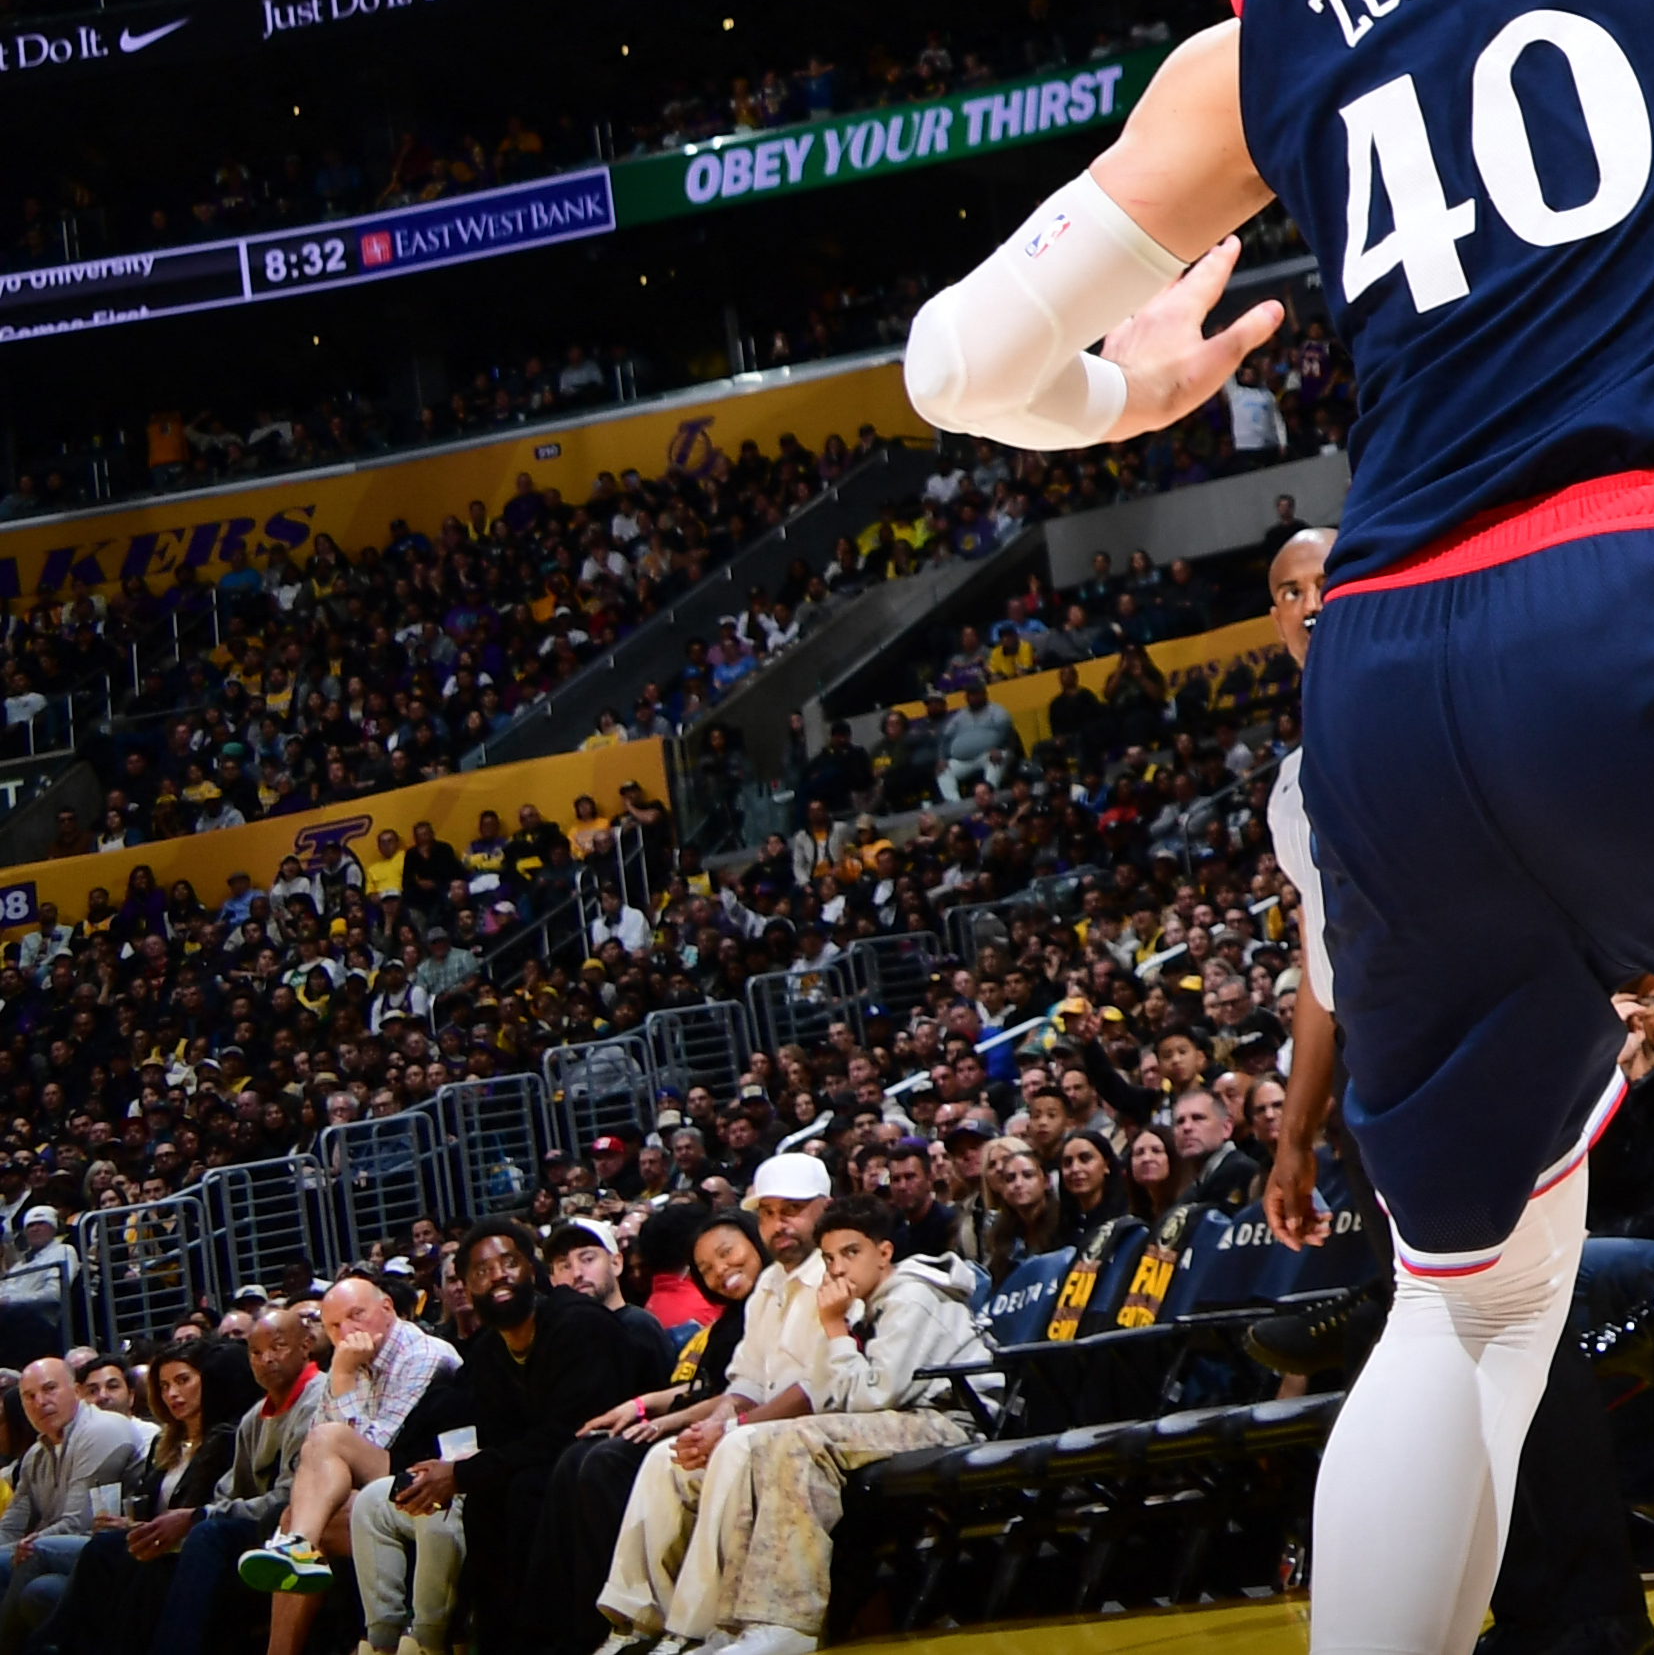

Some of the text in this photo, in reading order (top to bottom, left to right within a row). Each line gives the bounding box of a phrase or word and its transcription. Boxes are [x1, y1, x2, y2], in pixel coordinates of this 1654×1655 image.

[17, 35, 72, 68] Do
[79, 27, 108, 58] It.
[687, 68, 1120, 202] OBEY YOUR THIRST
[1338, 8, 1652, 314] 40
[265, 239, 346, 282] 8:32
[991, 1281, 1042, 1317] DELTA
